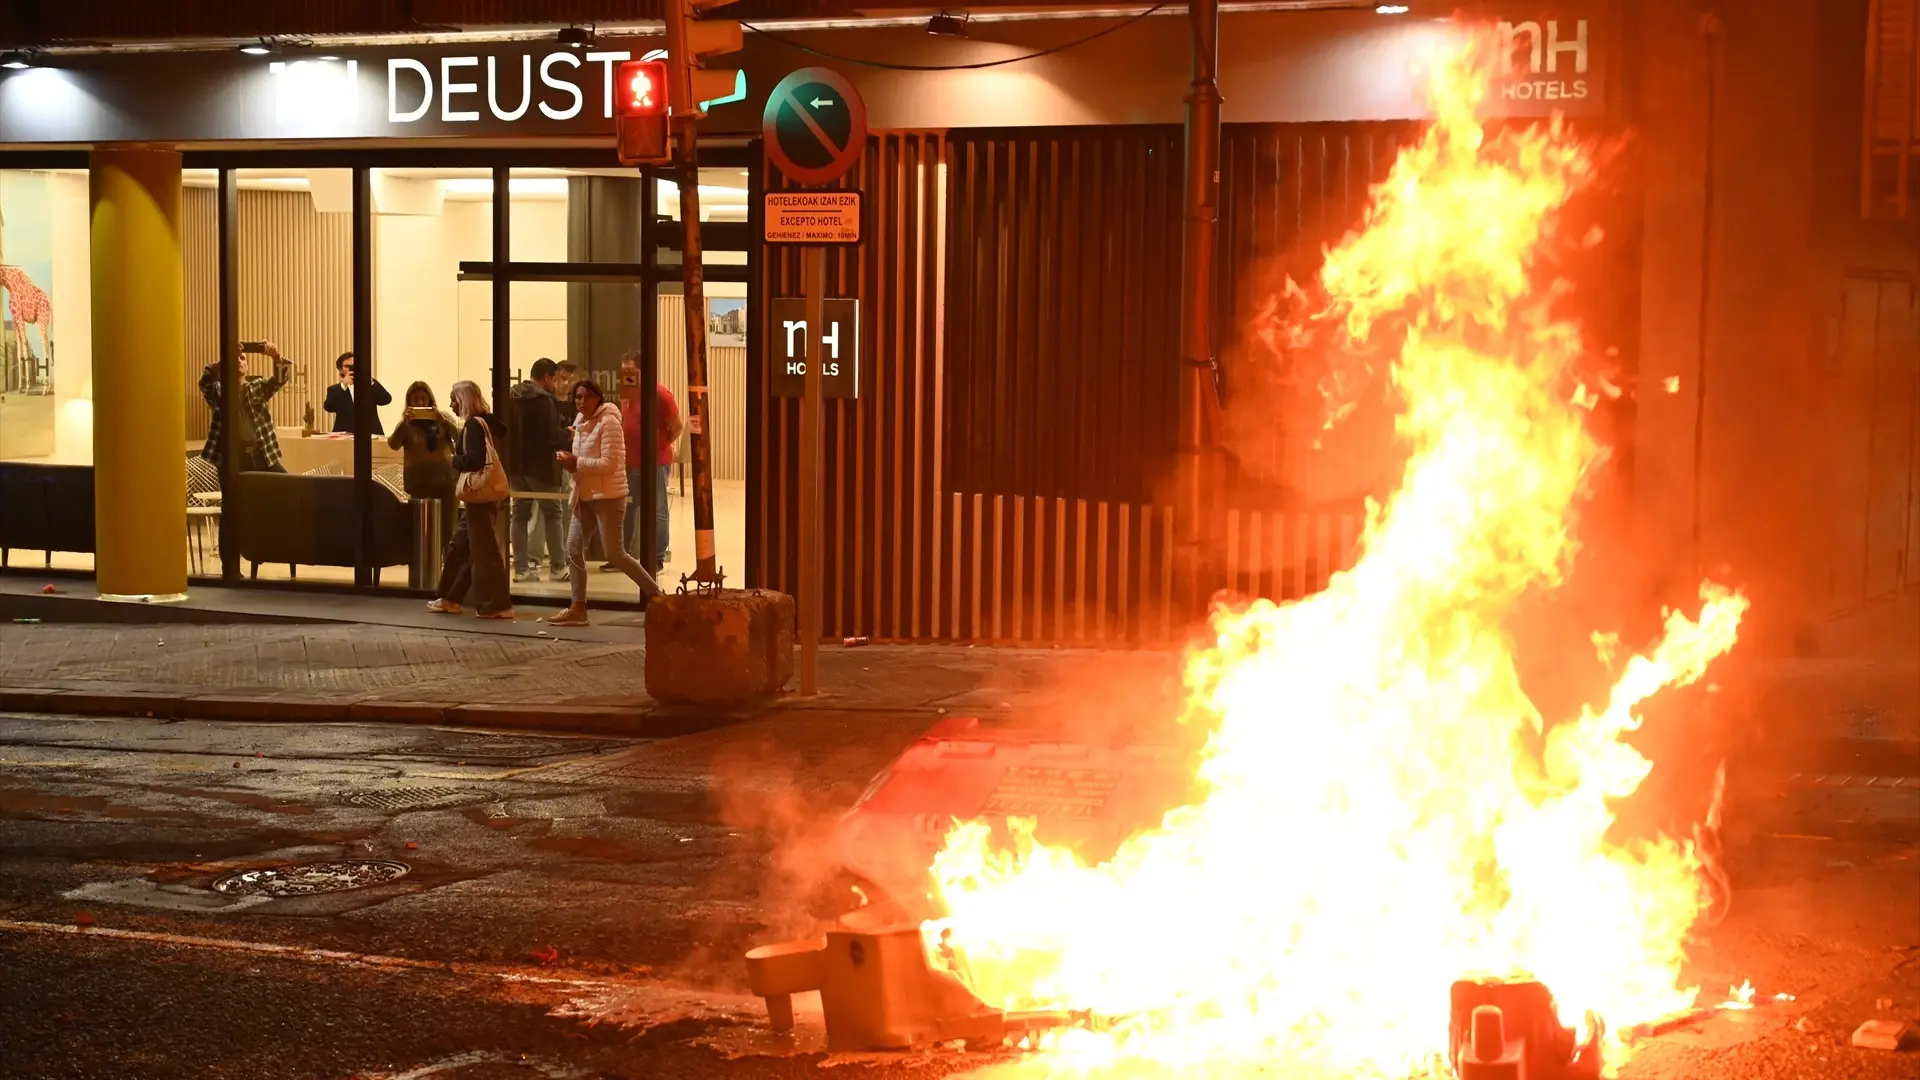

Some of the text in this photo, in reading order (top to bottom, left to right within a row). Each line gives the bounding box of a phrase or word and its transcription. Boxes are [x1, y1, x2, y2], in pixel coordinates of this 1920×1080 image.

[1501, 80, 1588, 100] HOTELS
[768, 196, 856, 206] HOTELEKOAK IZAN EZIK
[780, 216, 843, 226] EXCEPTO HOTEL
[786, 362, 839, 376] HOLS
